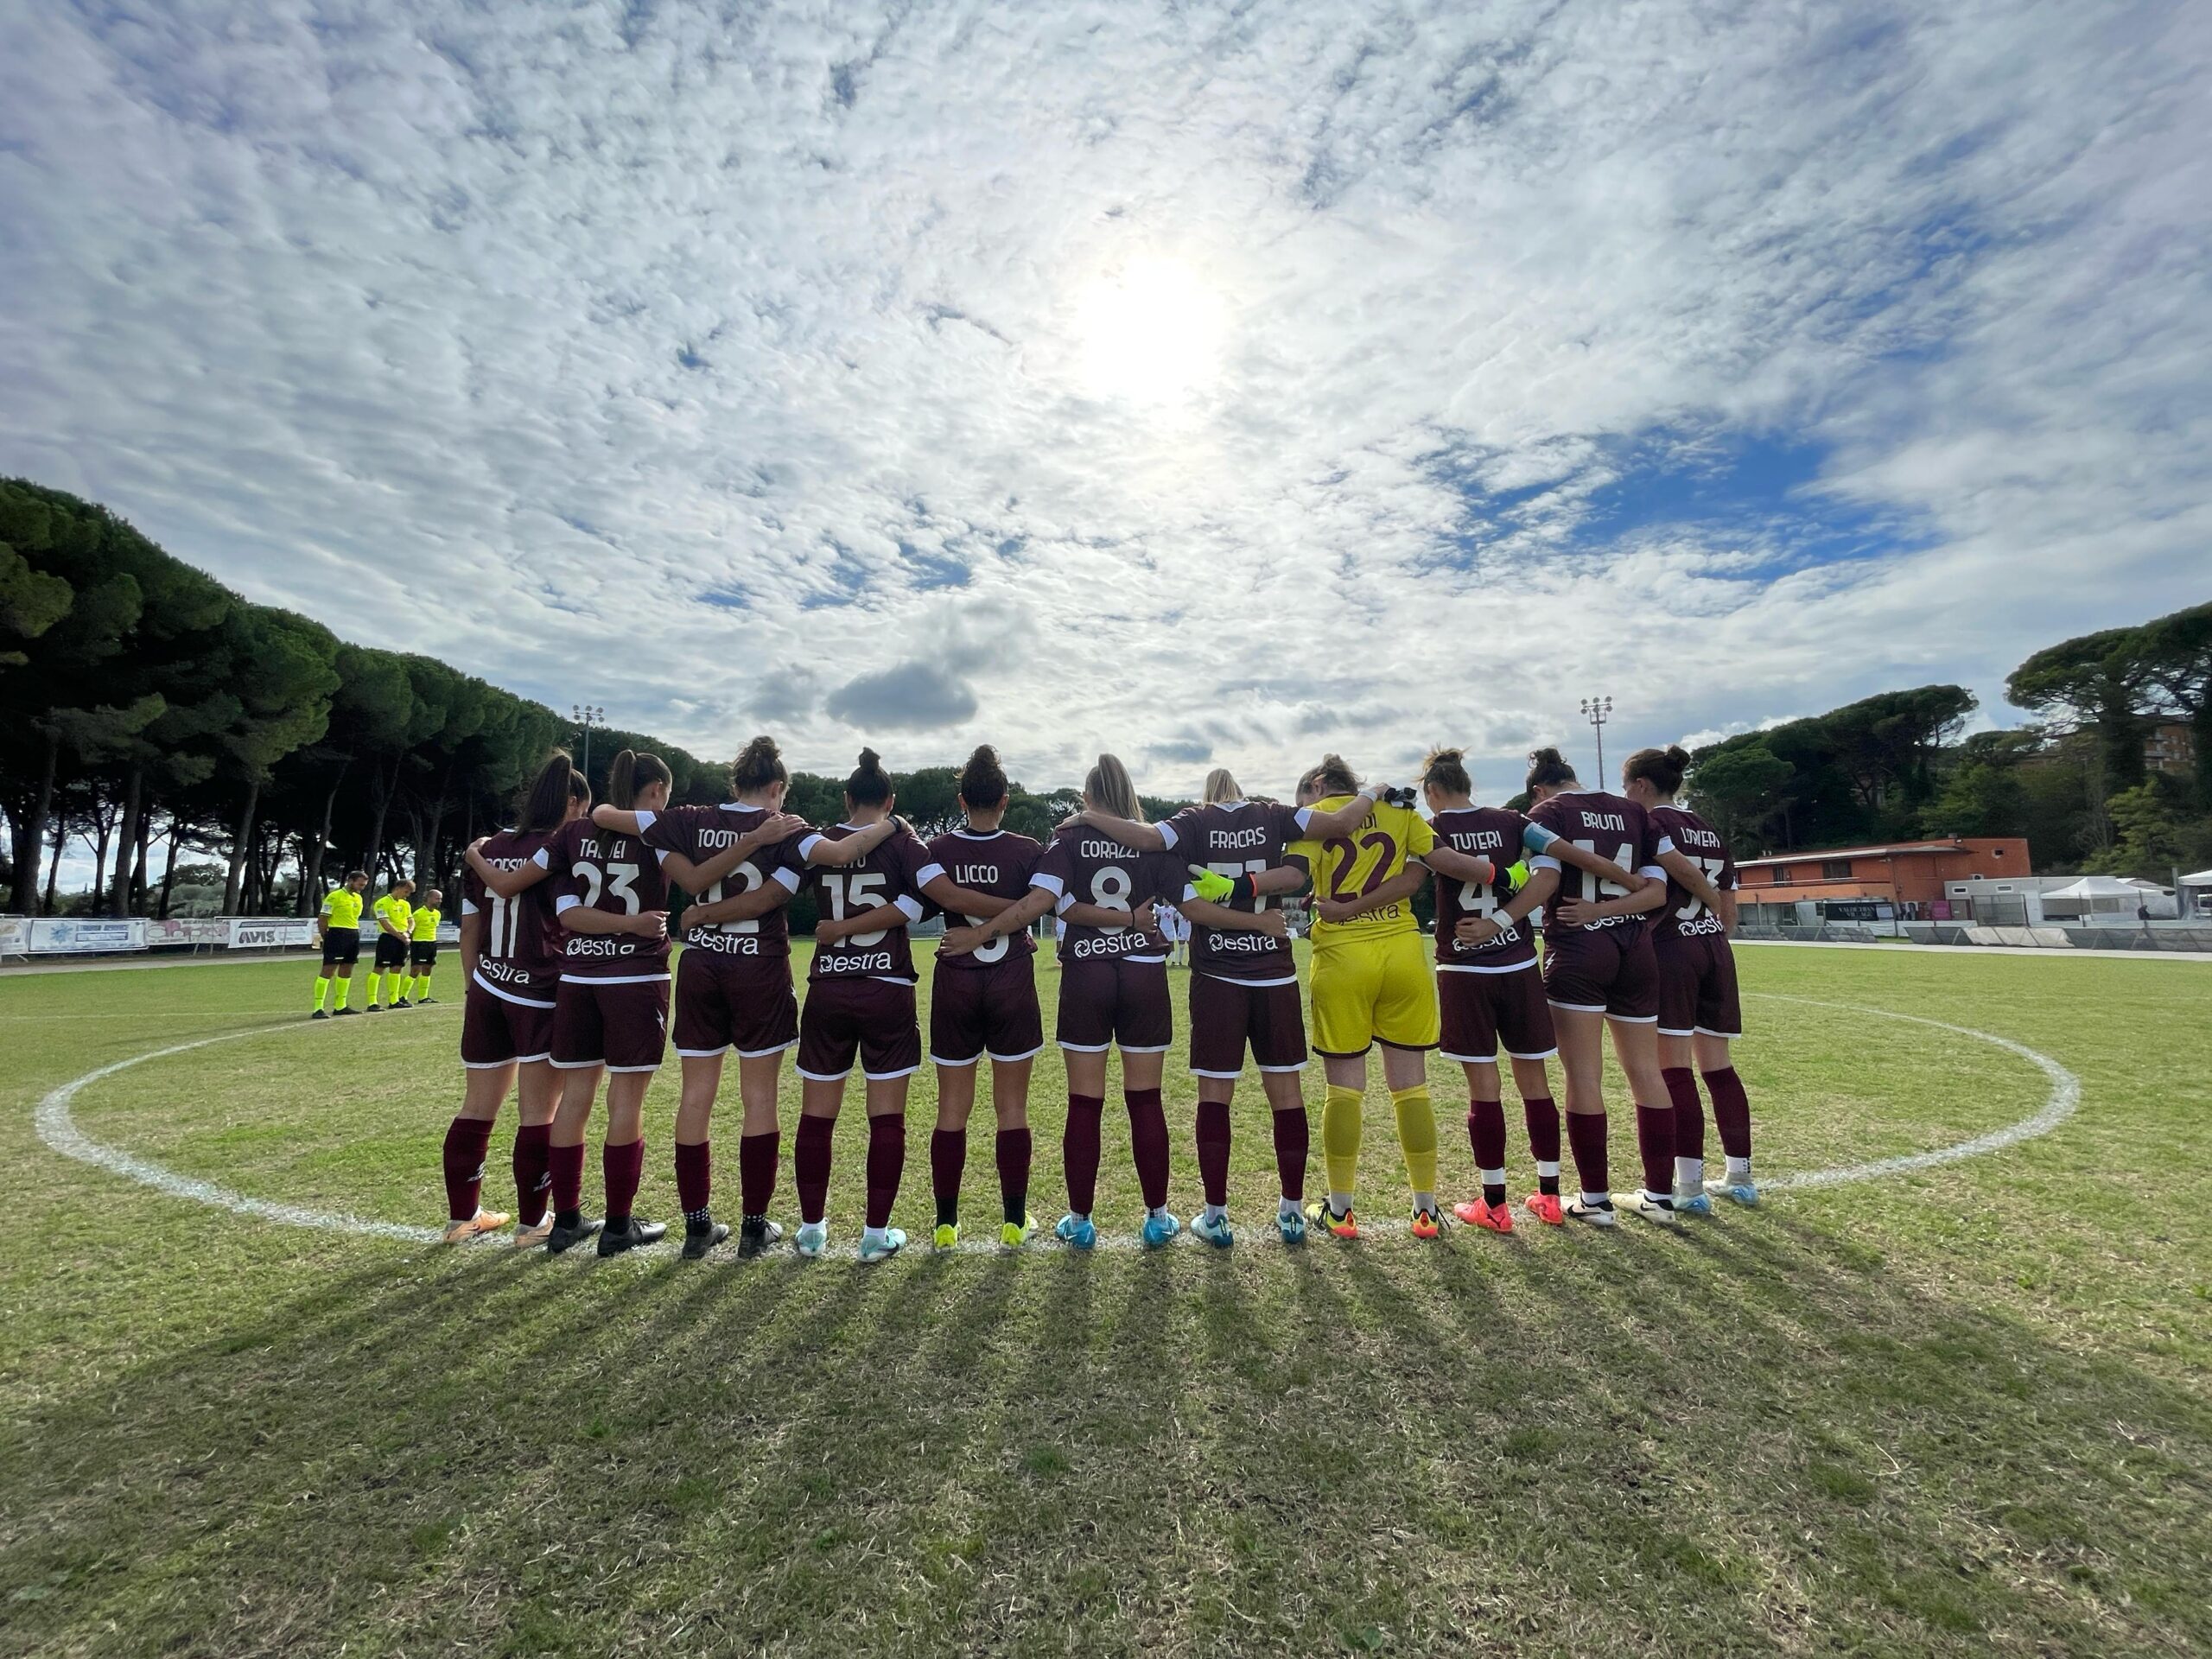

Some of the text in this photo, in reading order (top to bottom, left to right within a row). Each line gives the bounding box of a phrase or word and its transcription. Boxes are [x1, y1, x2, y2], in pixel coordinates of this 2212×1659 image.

[1580, 810, 1624, 830] BRUNI
[580, 838, 626, 859] TAEI
[1210, 826, 1267, 849] FRACAS
[1450, 830, 1503, 850] TUTERI
[955, 864, 999, 883] LICCO
[1322, 831, 1396, 904] 22
[1573, 839, 1633, 904] 14
[572, 861, 640, 936] 23
[1458, 854, 1498, 921] 4
[822, 873, 888, 948] 15
[1090, 866, 1132, 935] 8
[239, 930, 276, 944] AVIS
[701, 932, 760, 955] estra
[1091, 932, 1150, 954] estra
[1224, 934, 1279, 951] estra
[834, 951, 893, 972] estra
